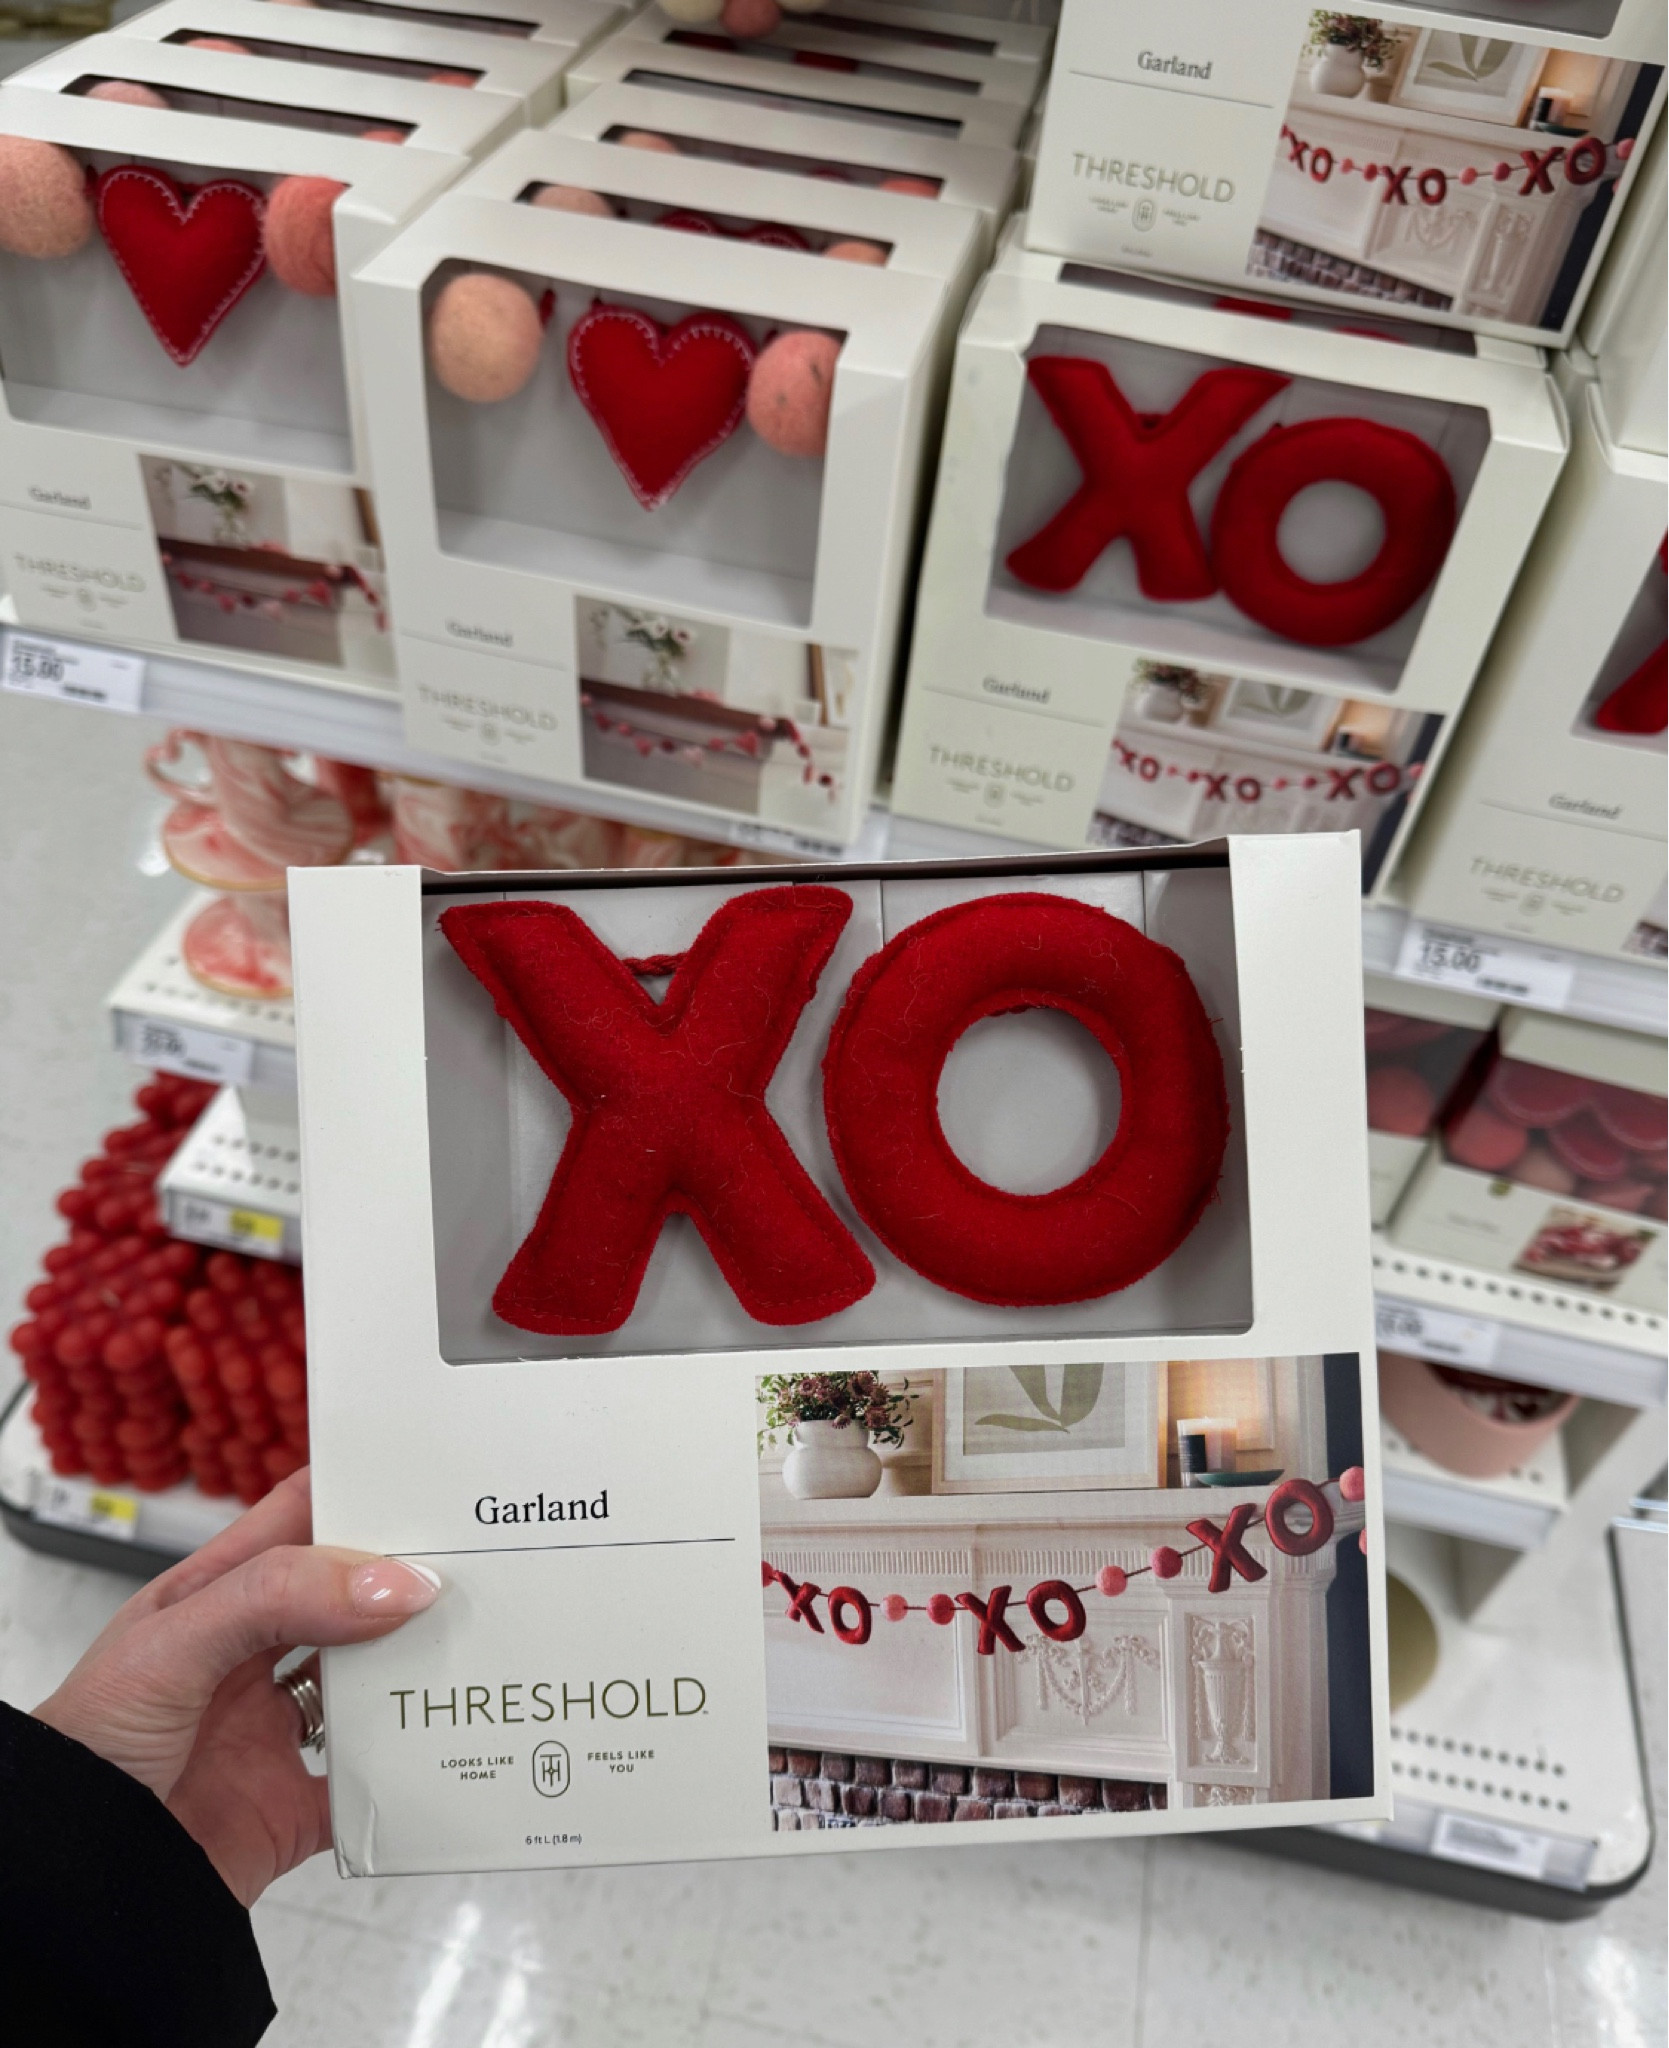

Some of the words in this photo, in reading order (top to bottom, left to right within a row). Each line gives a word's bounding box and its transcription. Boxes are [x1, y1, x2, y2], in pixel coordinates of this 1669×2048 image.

[1137, 50, 1213, 80] Garland
[1072, 152, 1236, 203] THRESHOLD
[982, 675, 1051, 705] Garland
[929, 744, 1076, 793] THRESHOLD
[1549, 793, 1624, 821] Garland
[1468, 855, 1627, 903] THRESHOLD
[1422, 943, 1481, 974] 15.00
[474, 1488, 610, 1525] Garland
[440, 1757, 483, 1769] LOOKS
[486, 1755, 515, 1766] LIKE
[587, 1751, 624, 1761] FEELS
[627, 1749, 655, 1760] LIKE
[609, 1763, 635, 1774] YOU
[460, 1770, 497, 1781] HOME
[525, 1835, 533, 1846] 6
[534, 1835, 543, 1844] ft
[544, 1834, 551, 1844] L
